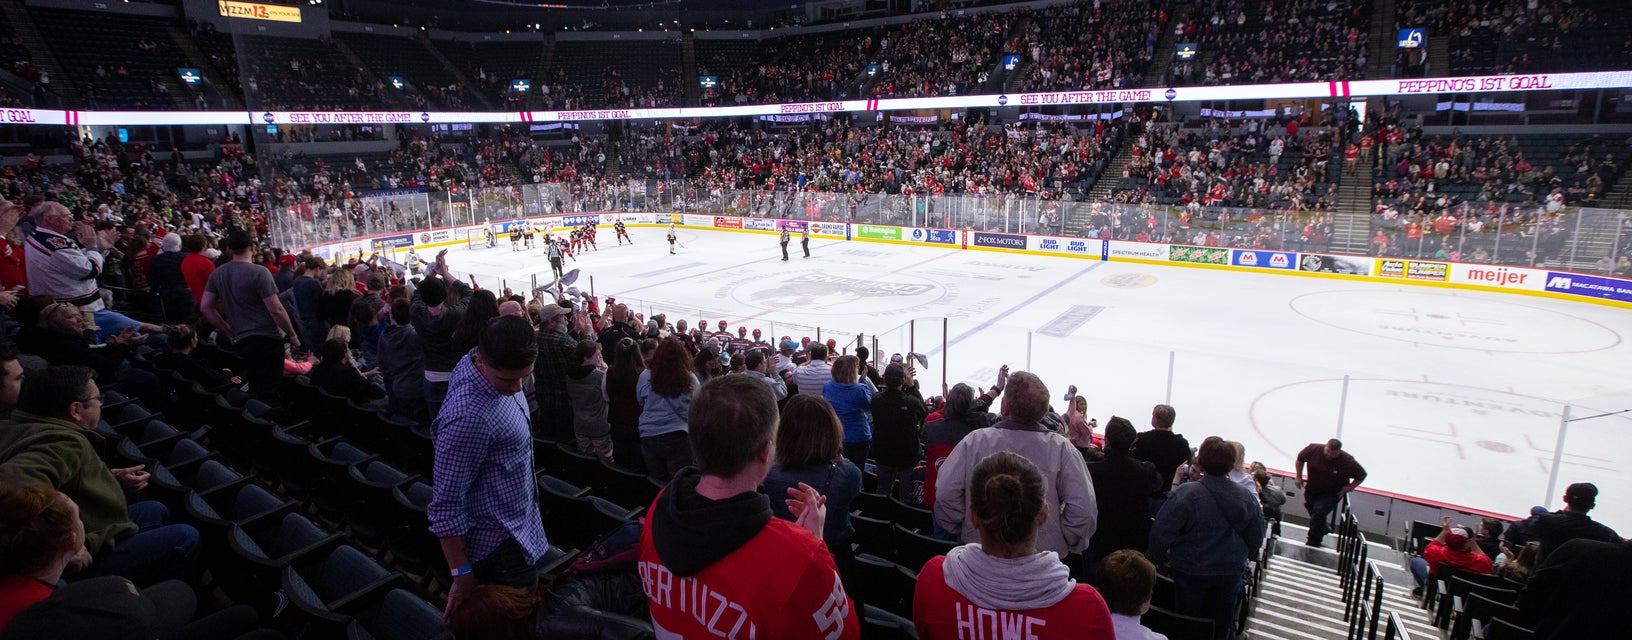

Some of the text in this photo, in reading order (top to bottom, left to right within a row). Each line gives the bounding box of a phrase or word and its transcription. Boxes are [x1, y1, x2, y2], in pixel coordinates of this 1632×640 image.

[1398, 76, 1552, 93] PEPPINO'S 1ST GOAL
[1020, 91, 1150, 104] SEE YOU AFTER THE GAME!
[781, 102, 844, 112] PEPPINO'S 1ST GOAL
[8, 110, 35, 122] GOAL
[290, 113, 411, 123] SEE YOU AFTER THE GAME!
[557, 110, 631, 120] PEPPINO'S 1ST GOAL
[983, 236, 996, 244] FOX
[1468, 267, 1527, 286] meijer
[1572, 282, 1615, 292] MACATAWA
